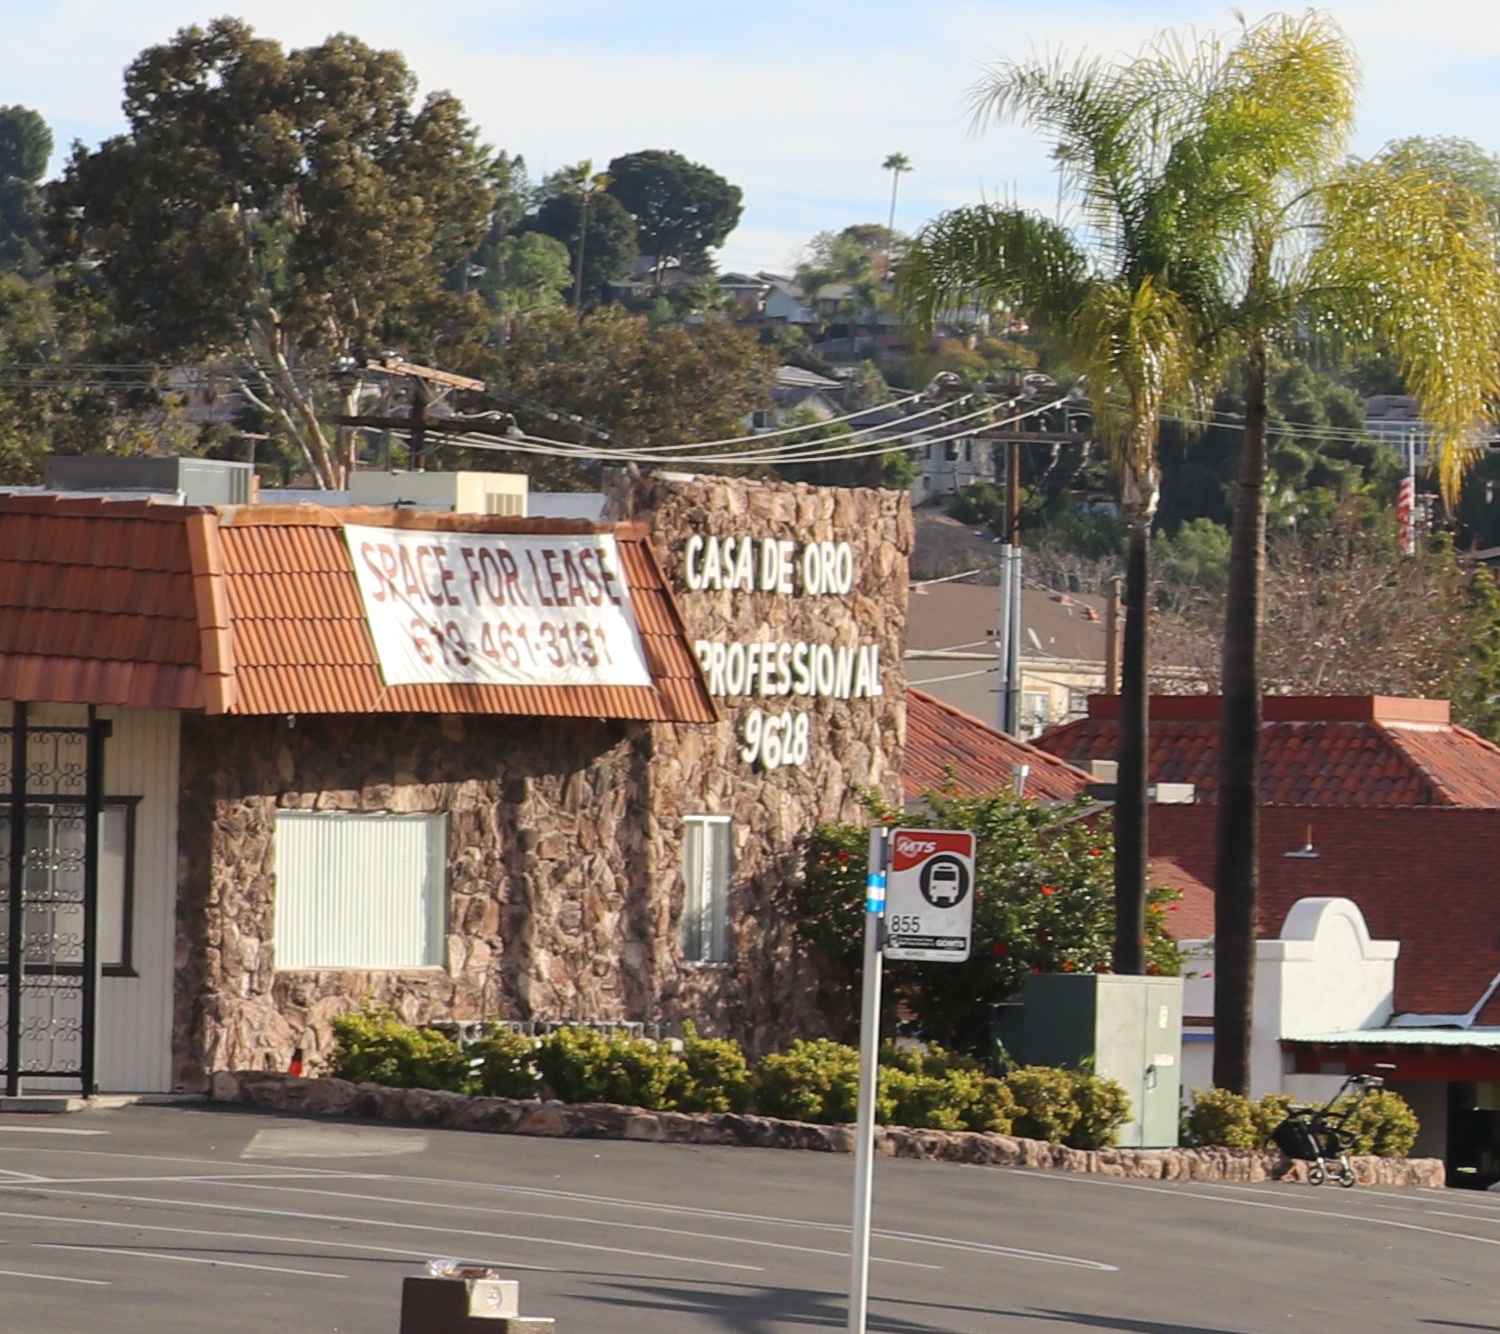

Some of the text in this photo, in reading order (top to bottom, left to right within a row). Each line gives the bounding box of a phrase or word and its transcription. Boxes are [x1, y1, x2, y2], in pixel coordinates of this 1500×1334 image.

[361, 541, 622, 607] SPACE FOR LEASE
[686, 535, 852, 595] CASA DE ORO
[411, 618, 612, 668] 619-461-3131
[695, 640, 883, 698] PROFESSIONAL
[741, 709, 809, 769] 9628
[897, 840, 937, 854] MTS
[891, 915, 921, 933] 855
